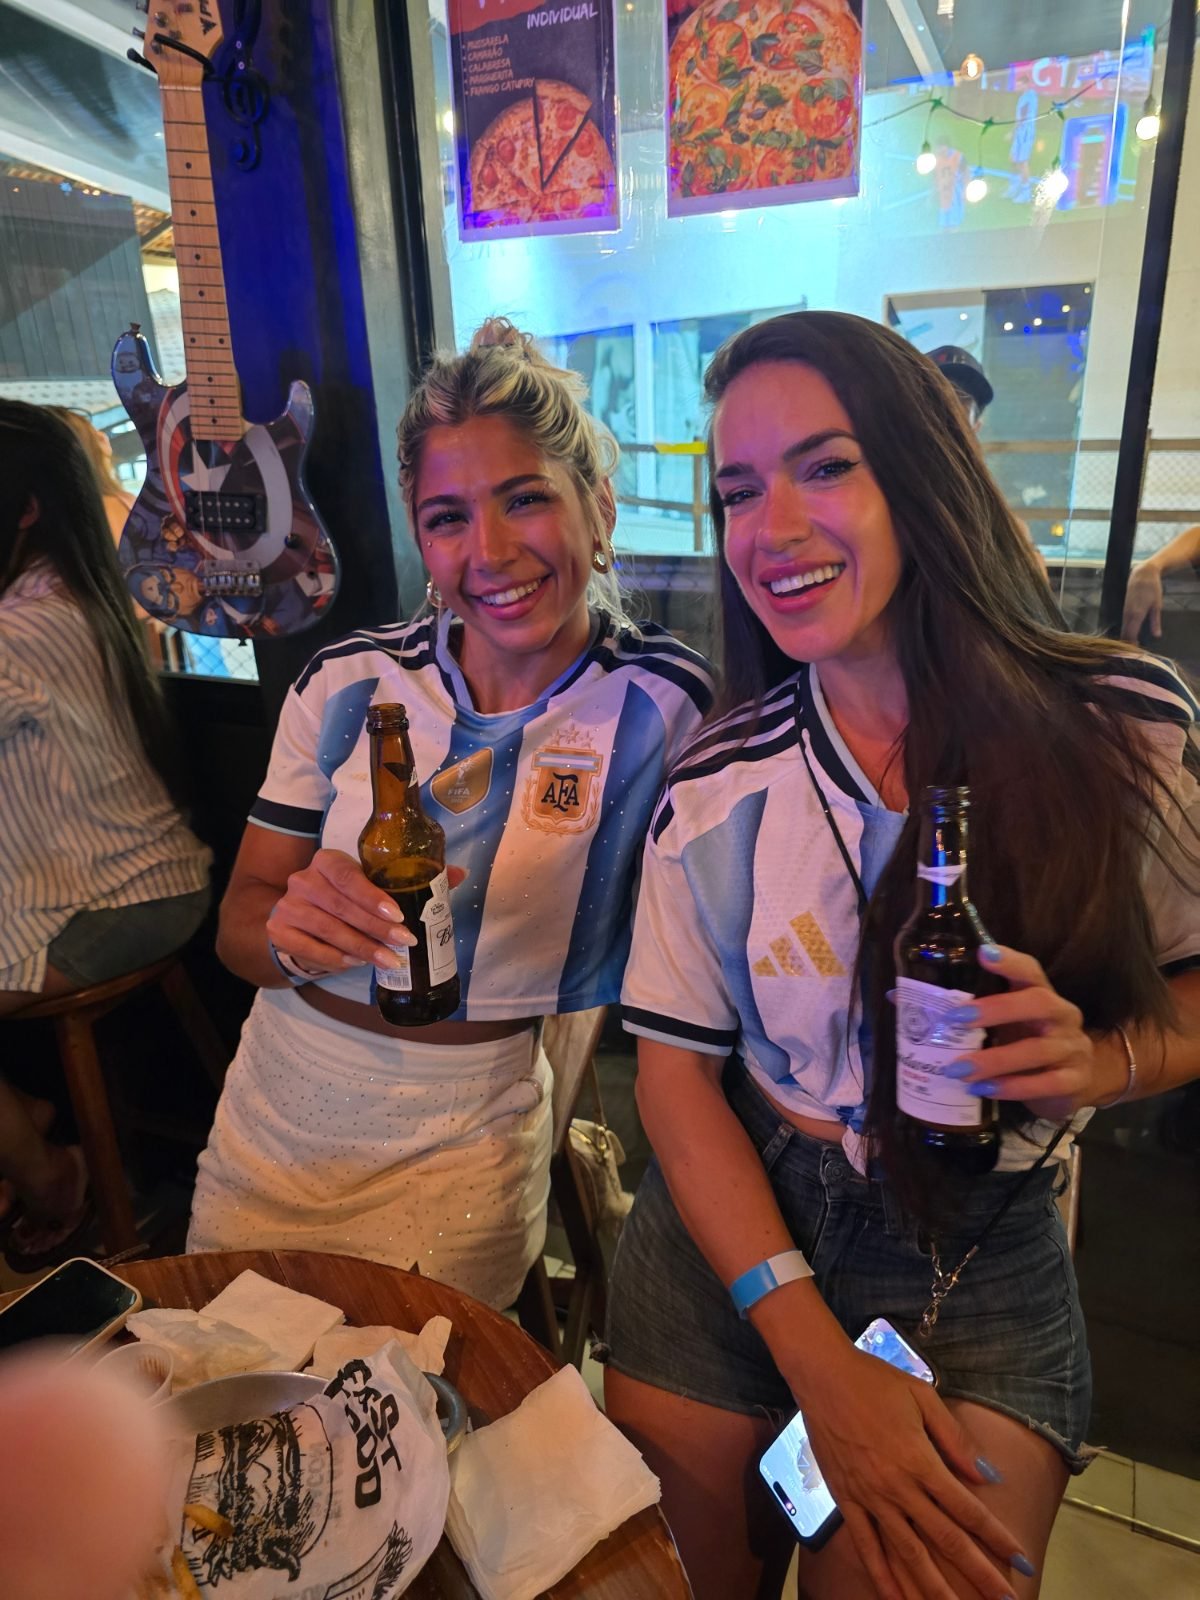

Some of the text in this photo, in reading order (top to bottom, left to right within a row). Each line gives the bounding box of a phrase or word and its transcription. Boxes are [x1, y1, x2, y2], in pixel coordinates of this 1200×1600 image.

[527, 3, 598, 30] INDIVIDUAL
[469, 57, 511, 73] CALABRESA
[501, 77, 535, 92] CATUPIRY
[447, 787, 470, 796] FIFA
[540, 771, 580, 812] AFA
[342, 1359, 402, 1472] FAST
